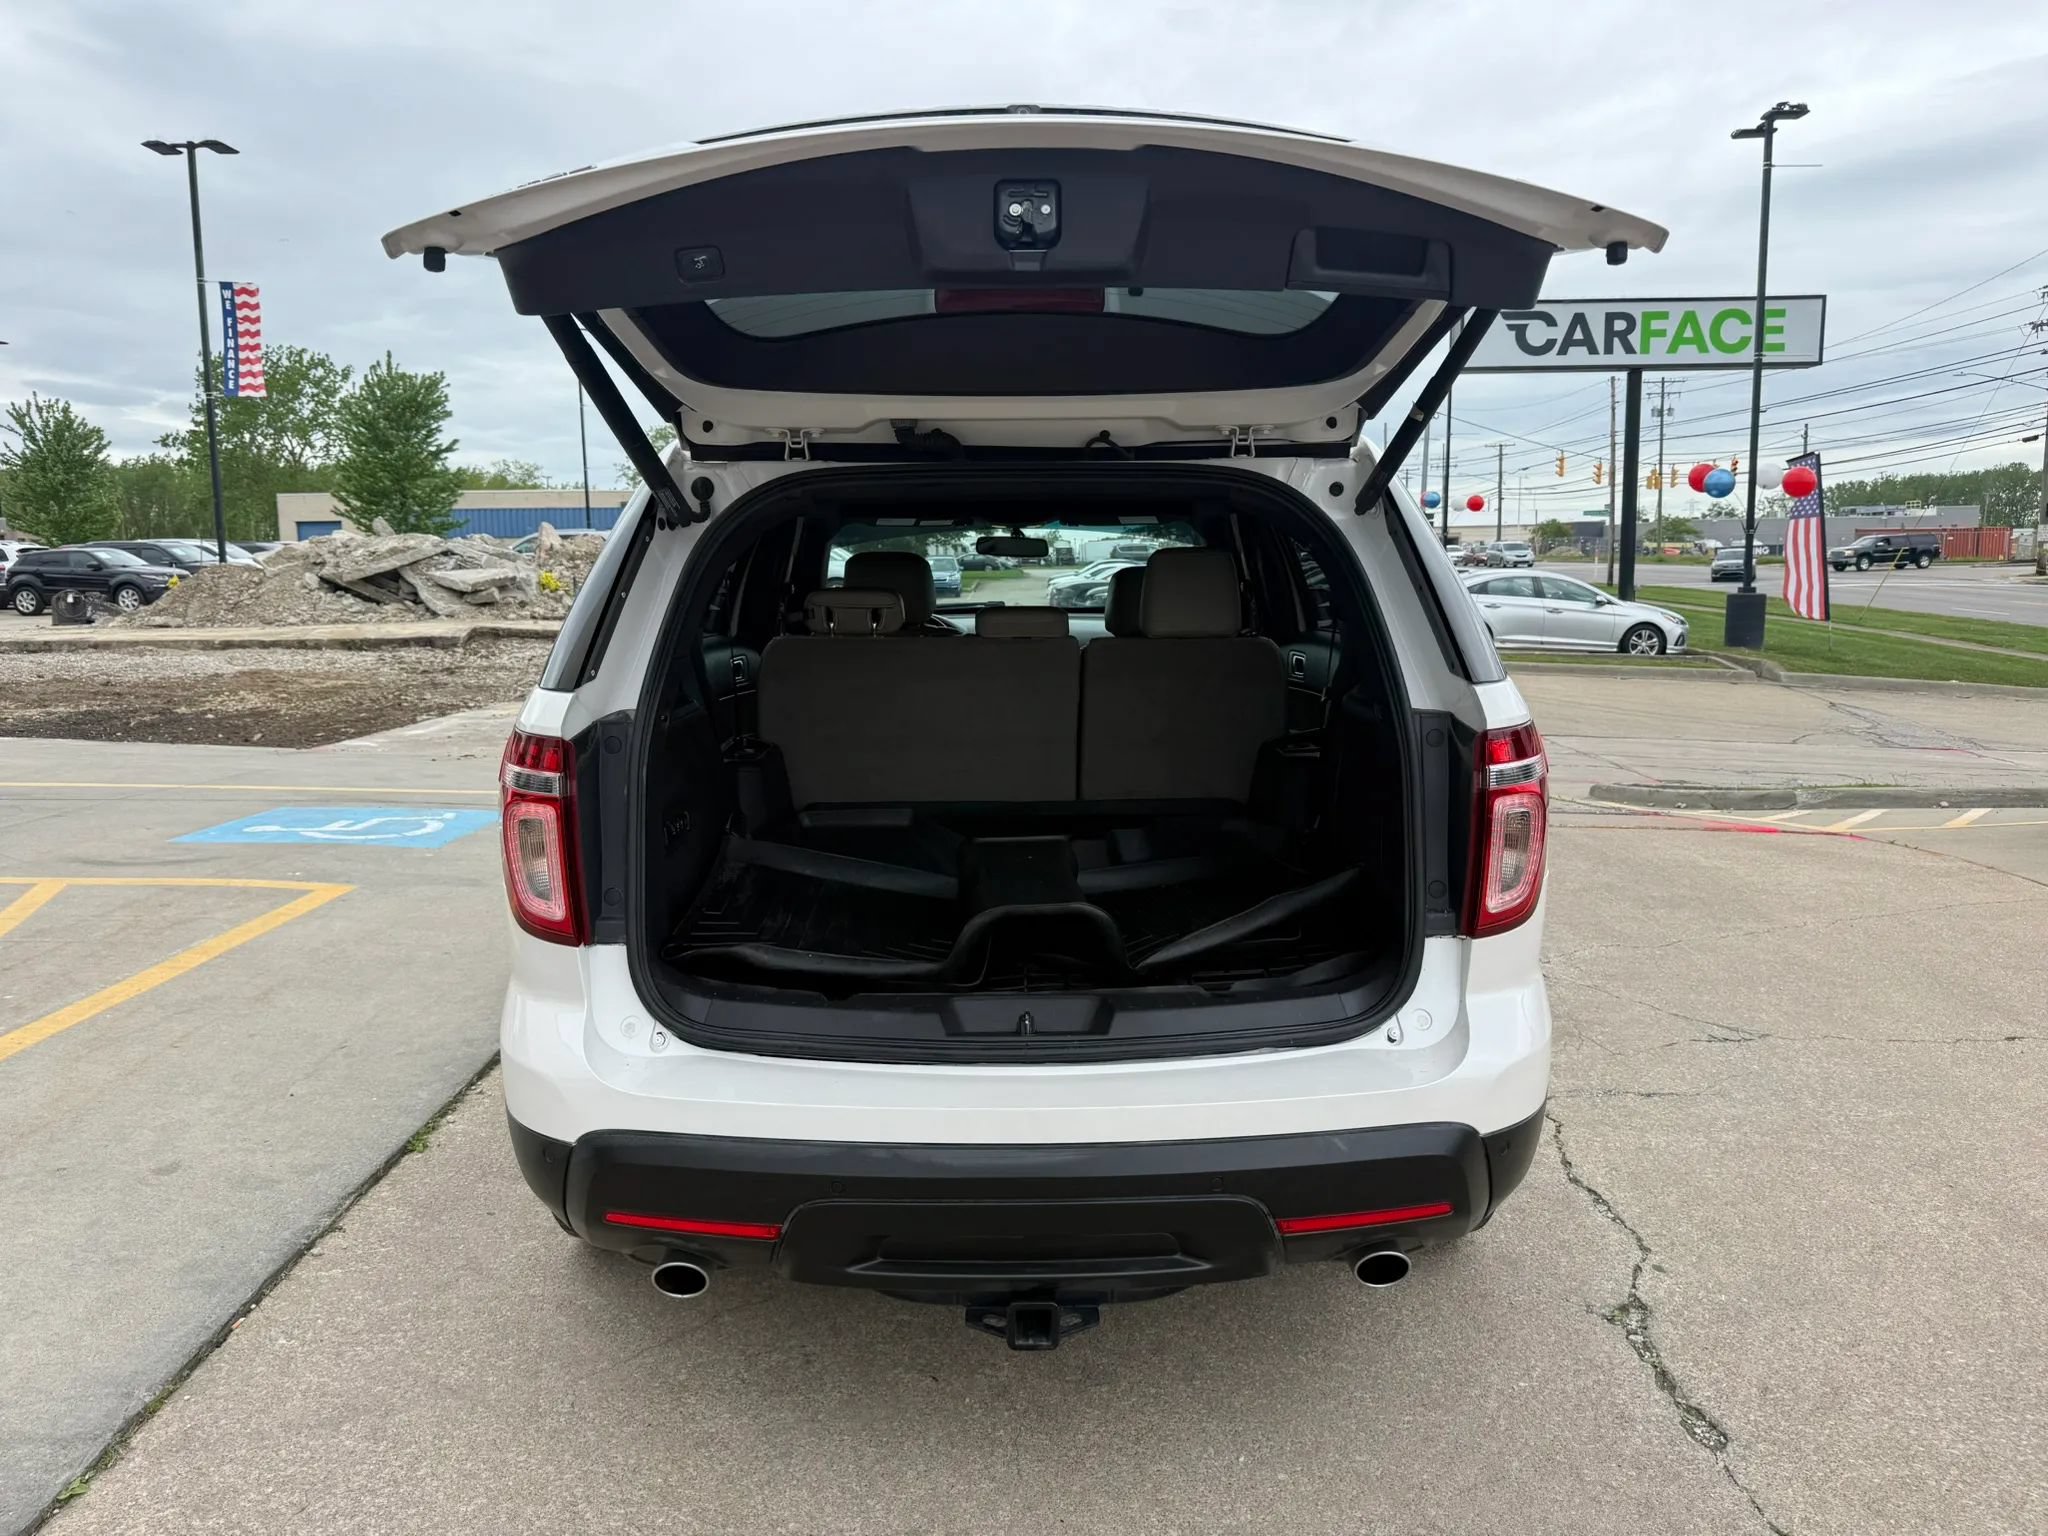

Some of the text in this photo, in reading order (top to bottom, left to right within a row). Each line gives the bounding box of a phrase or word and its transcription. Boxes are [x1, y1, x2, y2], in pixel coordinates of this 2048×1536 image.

[222, 289, 235, 389] WE FINANCE
[1500, 308, 1787, 356] CARFACE
